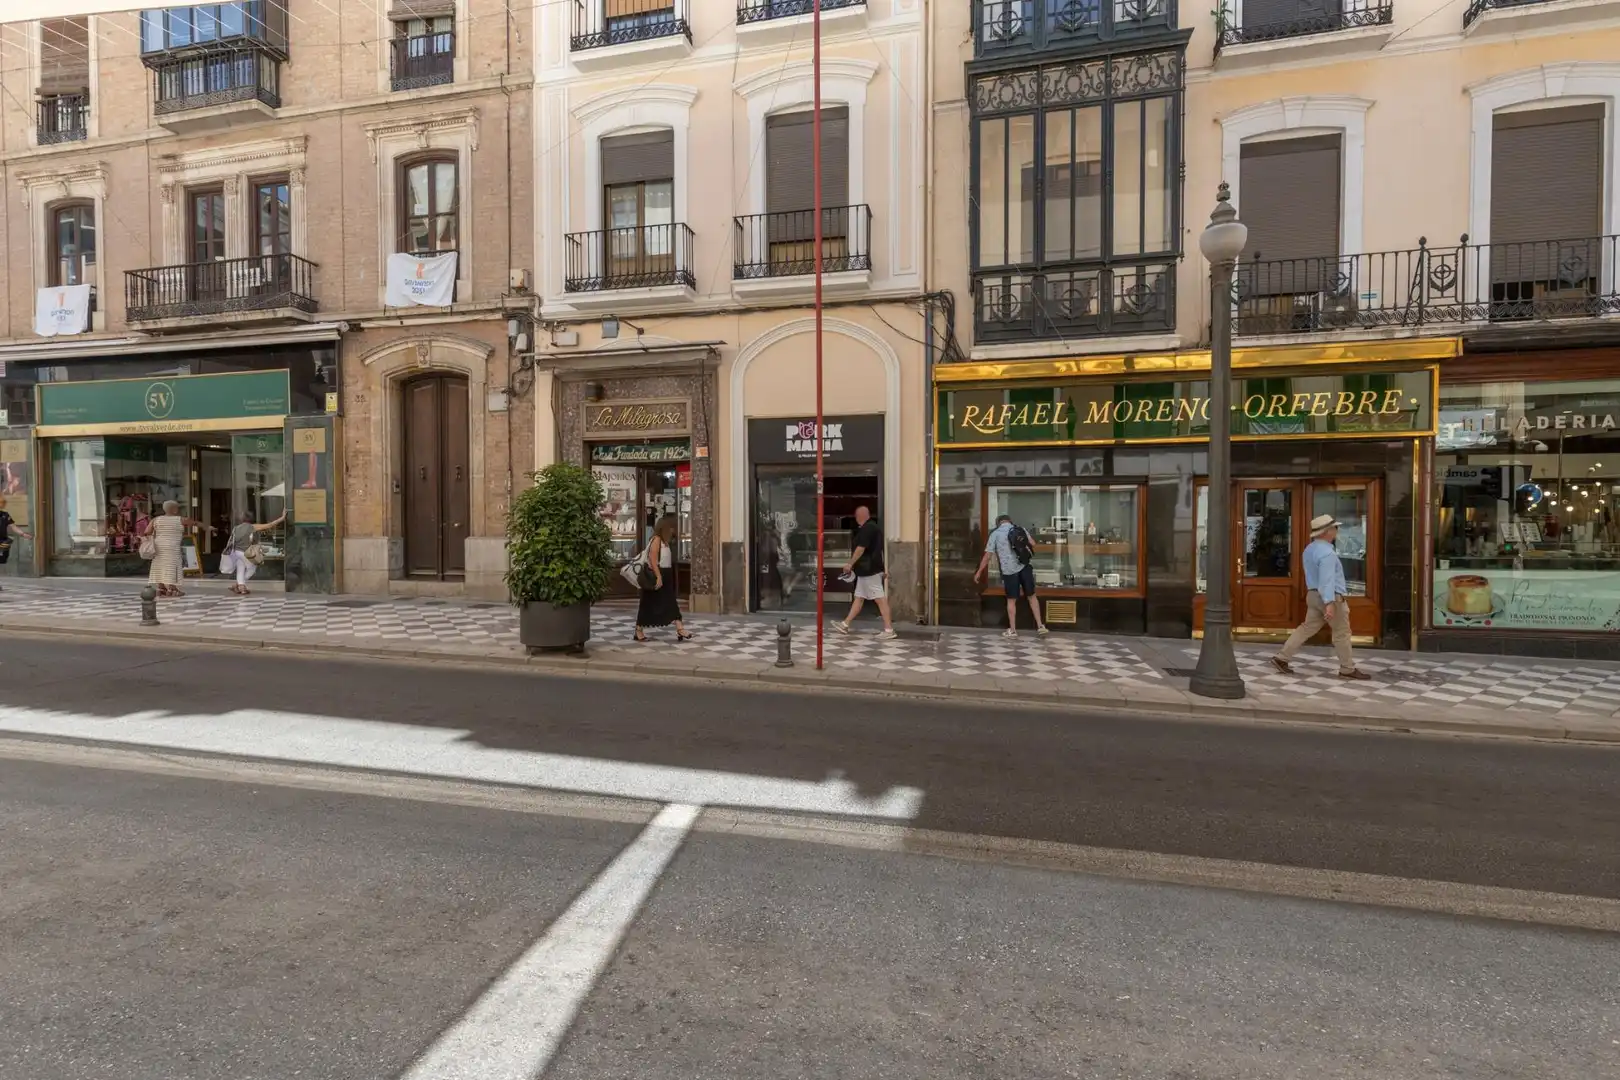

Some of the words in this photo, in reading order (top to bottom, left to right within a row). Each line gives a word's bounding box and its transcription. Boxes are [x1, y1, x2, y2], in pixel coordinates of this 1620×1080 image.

[150, 392, 170, 409] 5V
[593, 407, 612, 426] La
[613, 406, 681, 429] Milagrosa
[961, 402, 1069, 434] RAFAEL
[1244, 389, 1403, 418] ORFEBRE
[592, 446, 613, 461] Casa
[613, 445, 648, 460] Fundada
[650, 450, 661, 460] en
[664, 446, 685, 460] 1925
[592, 470, 637, 482] MAJORICA
